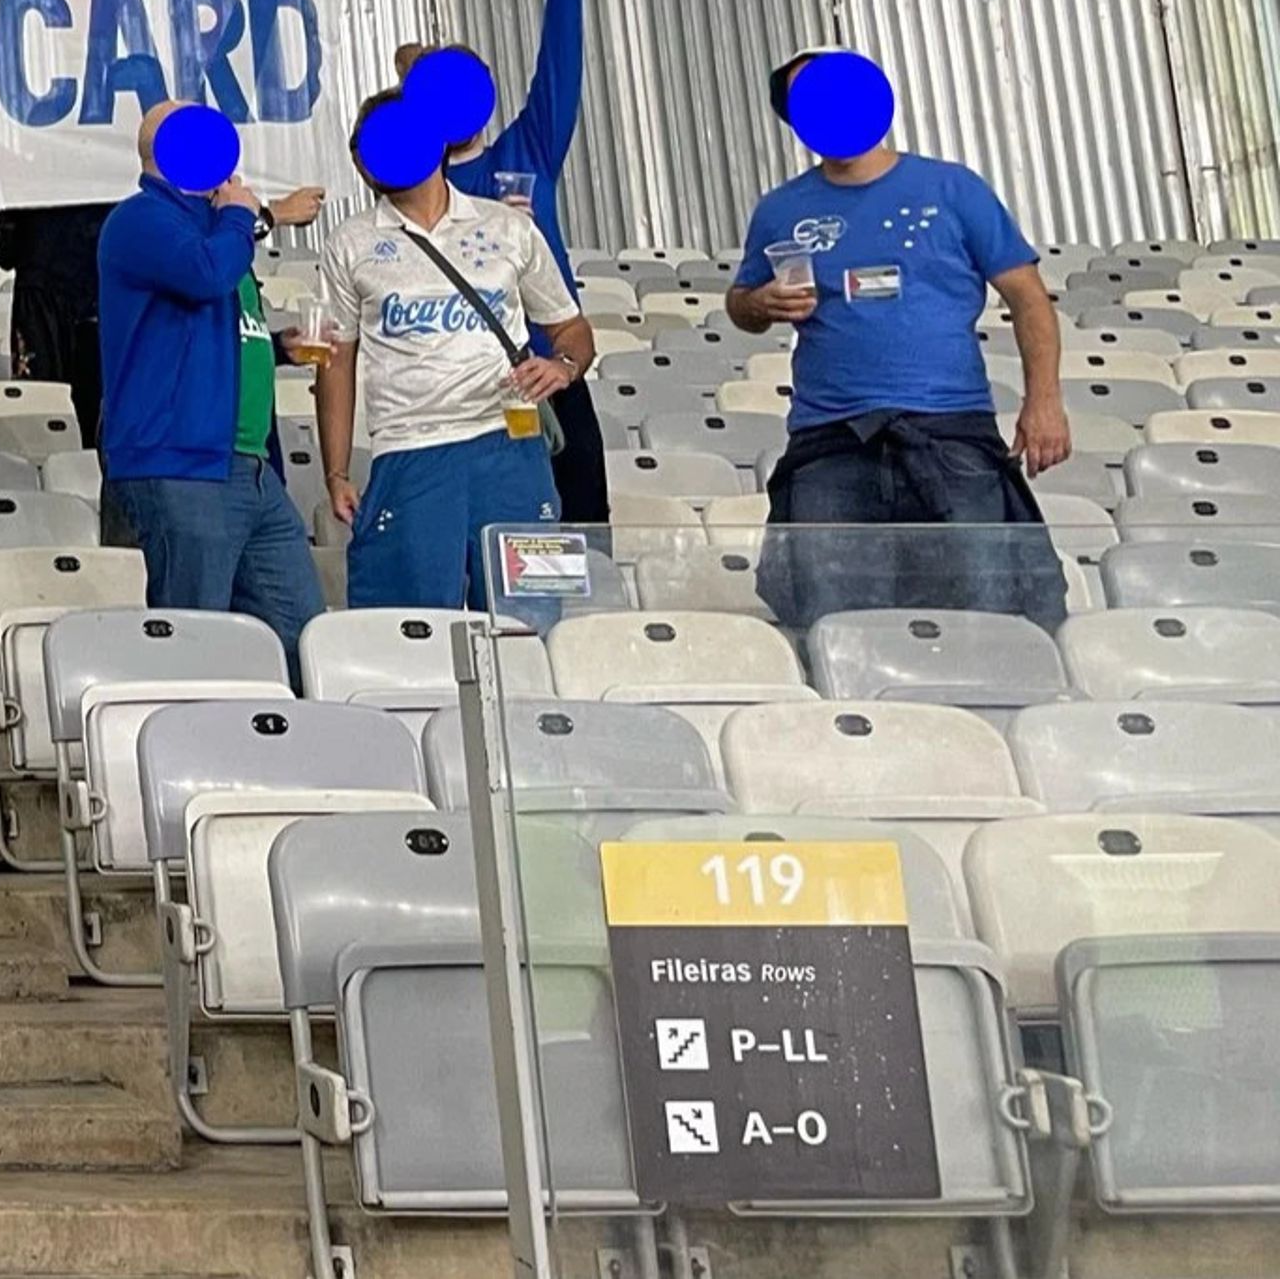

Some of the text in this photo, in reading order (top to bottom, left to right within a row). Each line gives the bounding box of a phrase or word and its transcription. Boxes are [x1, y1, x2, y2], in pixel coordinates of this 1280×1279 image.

[701, 854, 804, 906] 119
[651, 959, 816, 983] Fileiras Rows
[731, 1029, 829, 1063] P-LL
[742, 1111, 827, 1146] A-O
